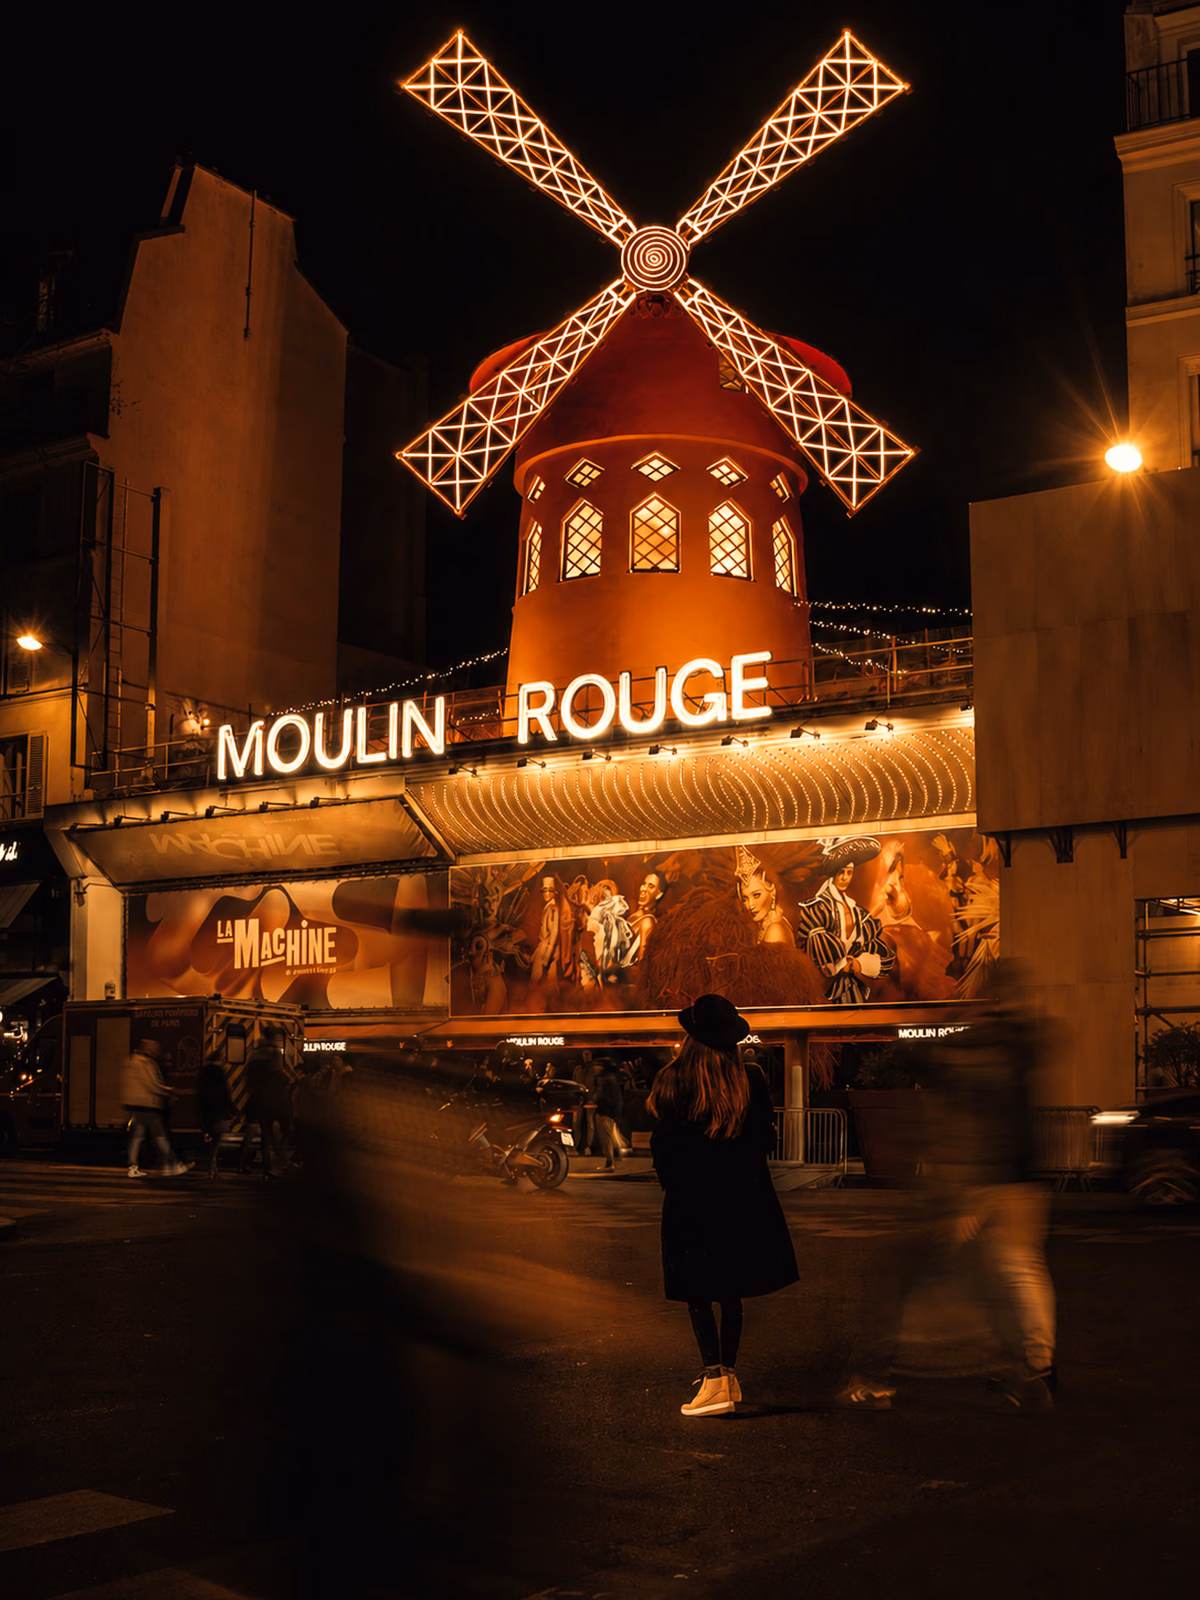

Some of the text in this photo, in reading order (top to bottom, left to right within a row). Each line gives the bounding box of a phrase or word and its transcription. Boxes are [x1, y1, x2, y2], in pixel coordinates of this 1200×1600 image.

[217, 651, 773, 780] MOULIN ROUGE
[217, 920, 233, 938] LA
[898, 1028, 936, 1039] MOULIN
[538, 1037, 565, 1046] ROUGE
